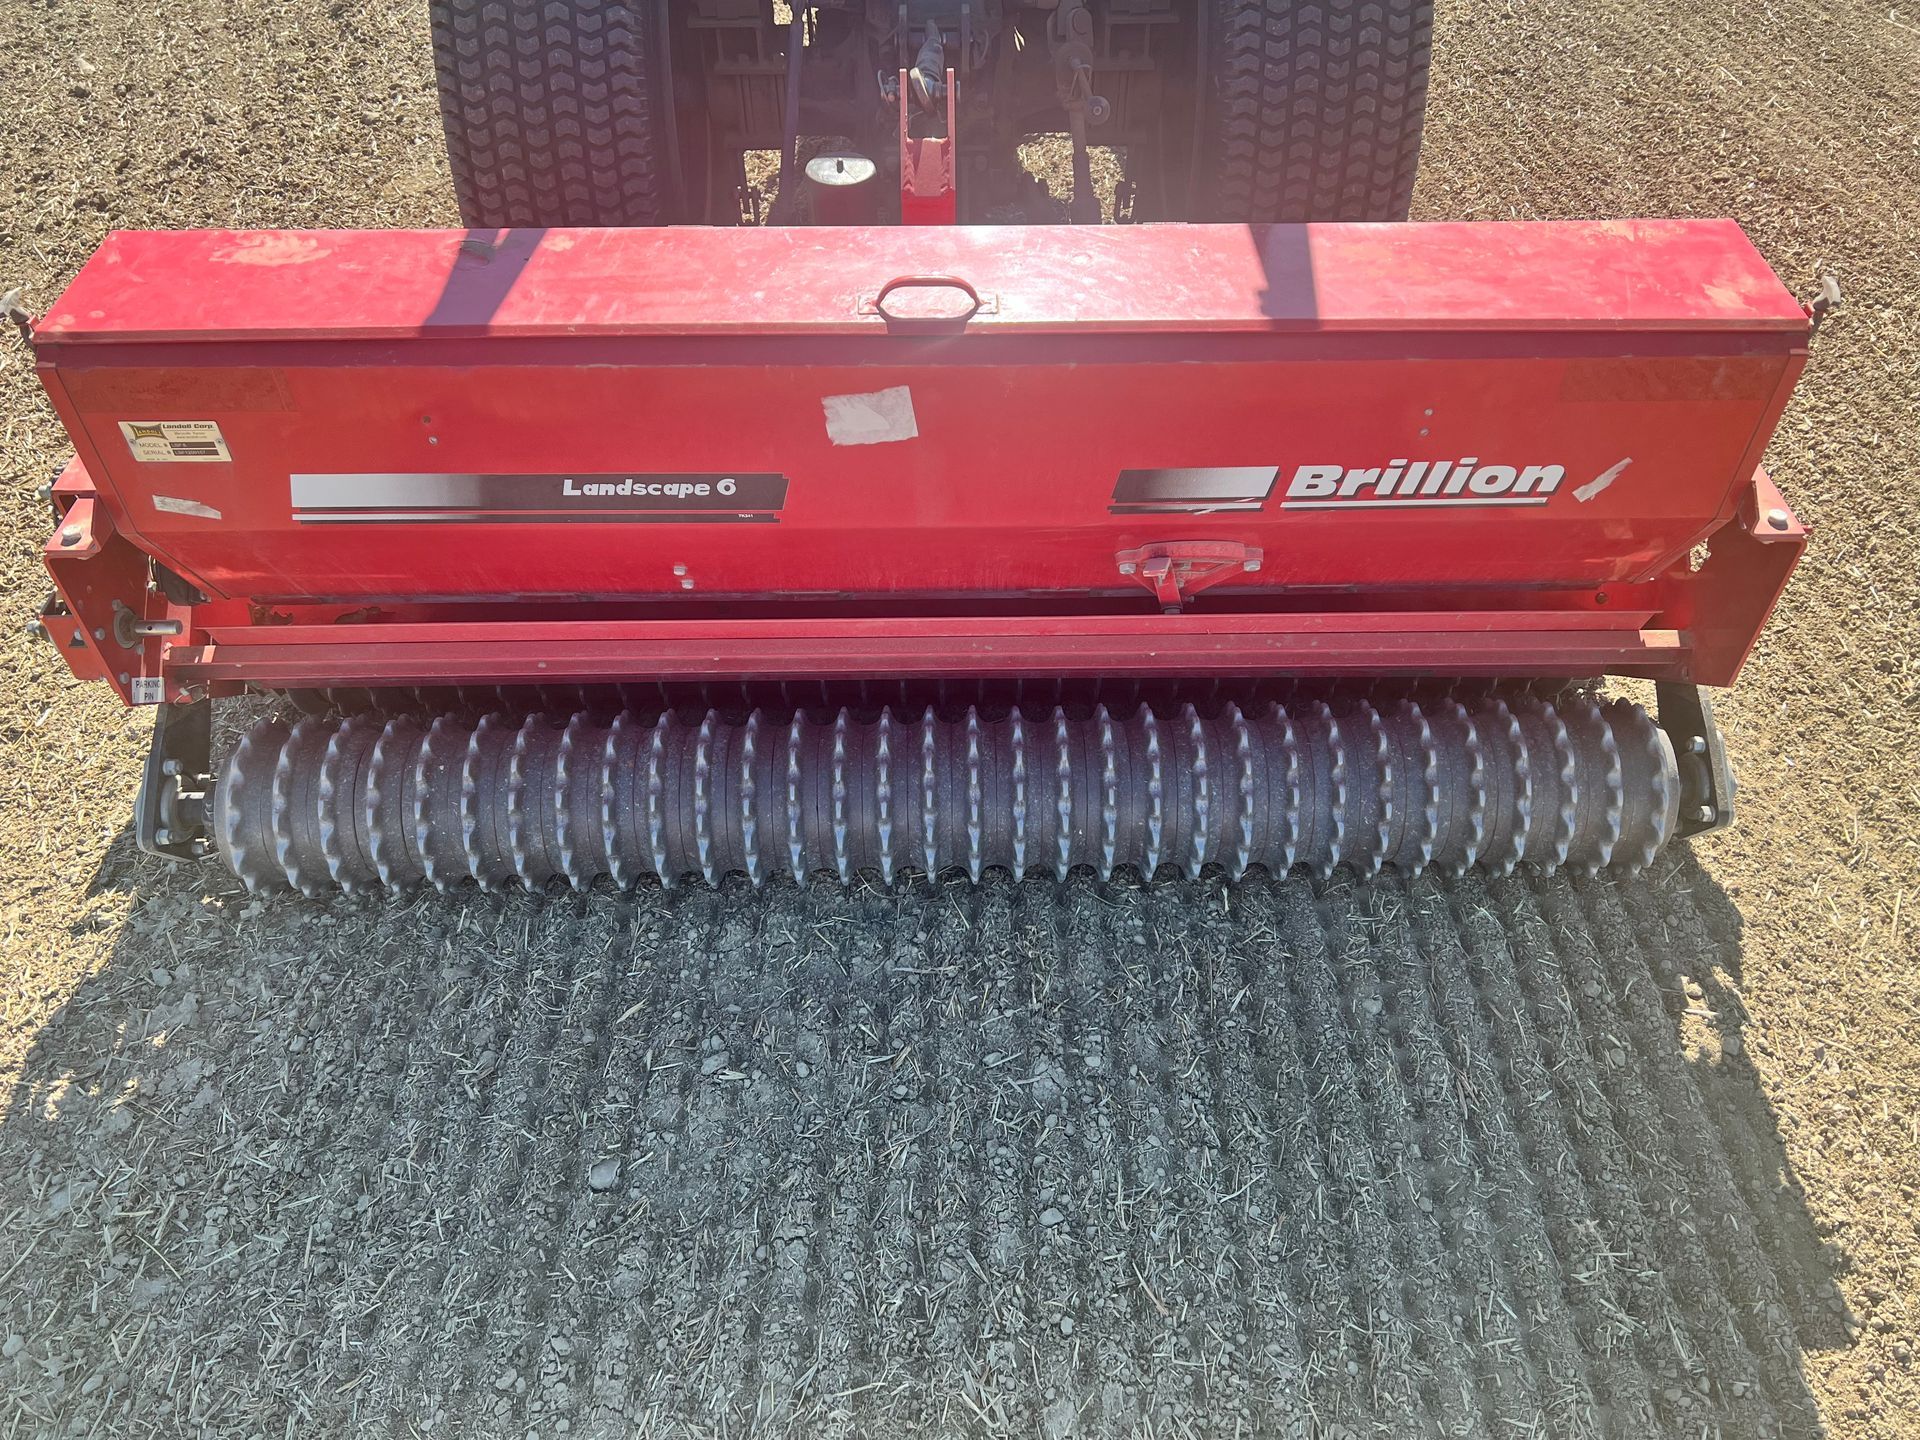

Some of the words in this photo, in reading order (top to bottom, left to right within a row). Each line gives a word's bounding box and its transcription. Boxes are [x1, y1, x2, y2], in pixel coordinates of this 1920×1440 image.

[1285, 457, 1566, 498] Brillion
[562, 478, 710, 498] Landscape
[716, 478, 737, 496] 6
[135, 680, 161, 688] PARKING
[144, 692, 154, 700] PIN
